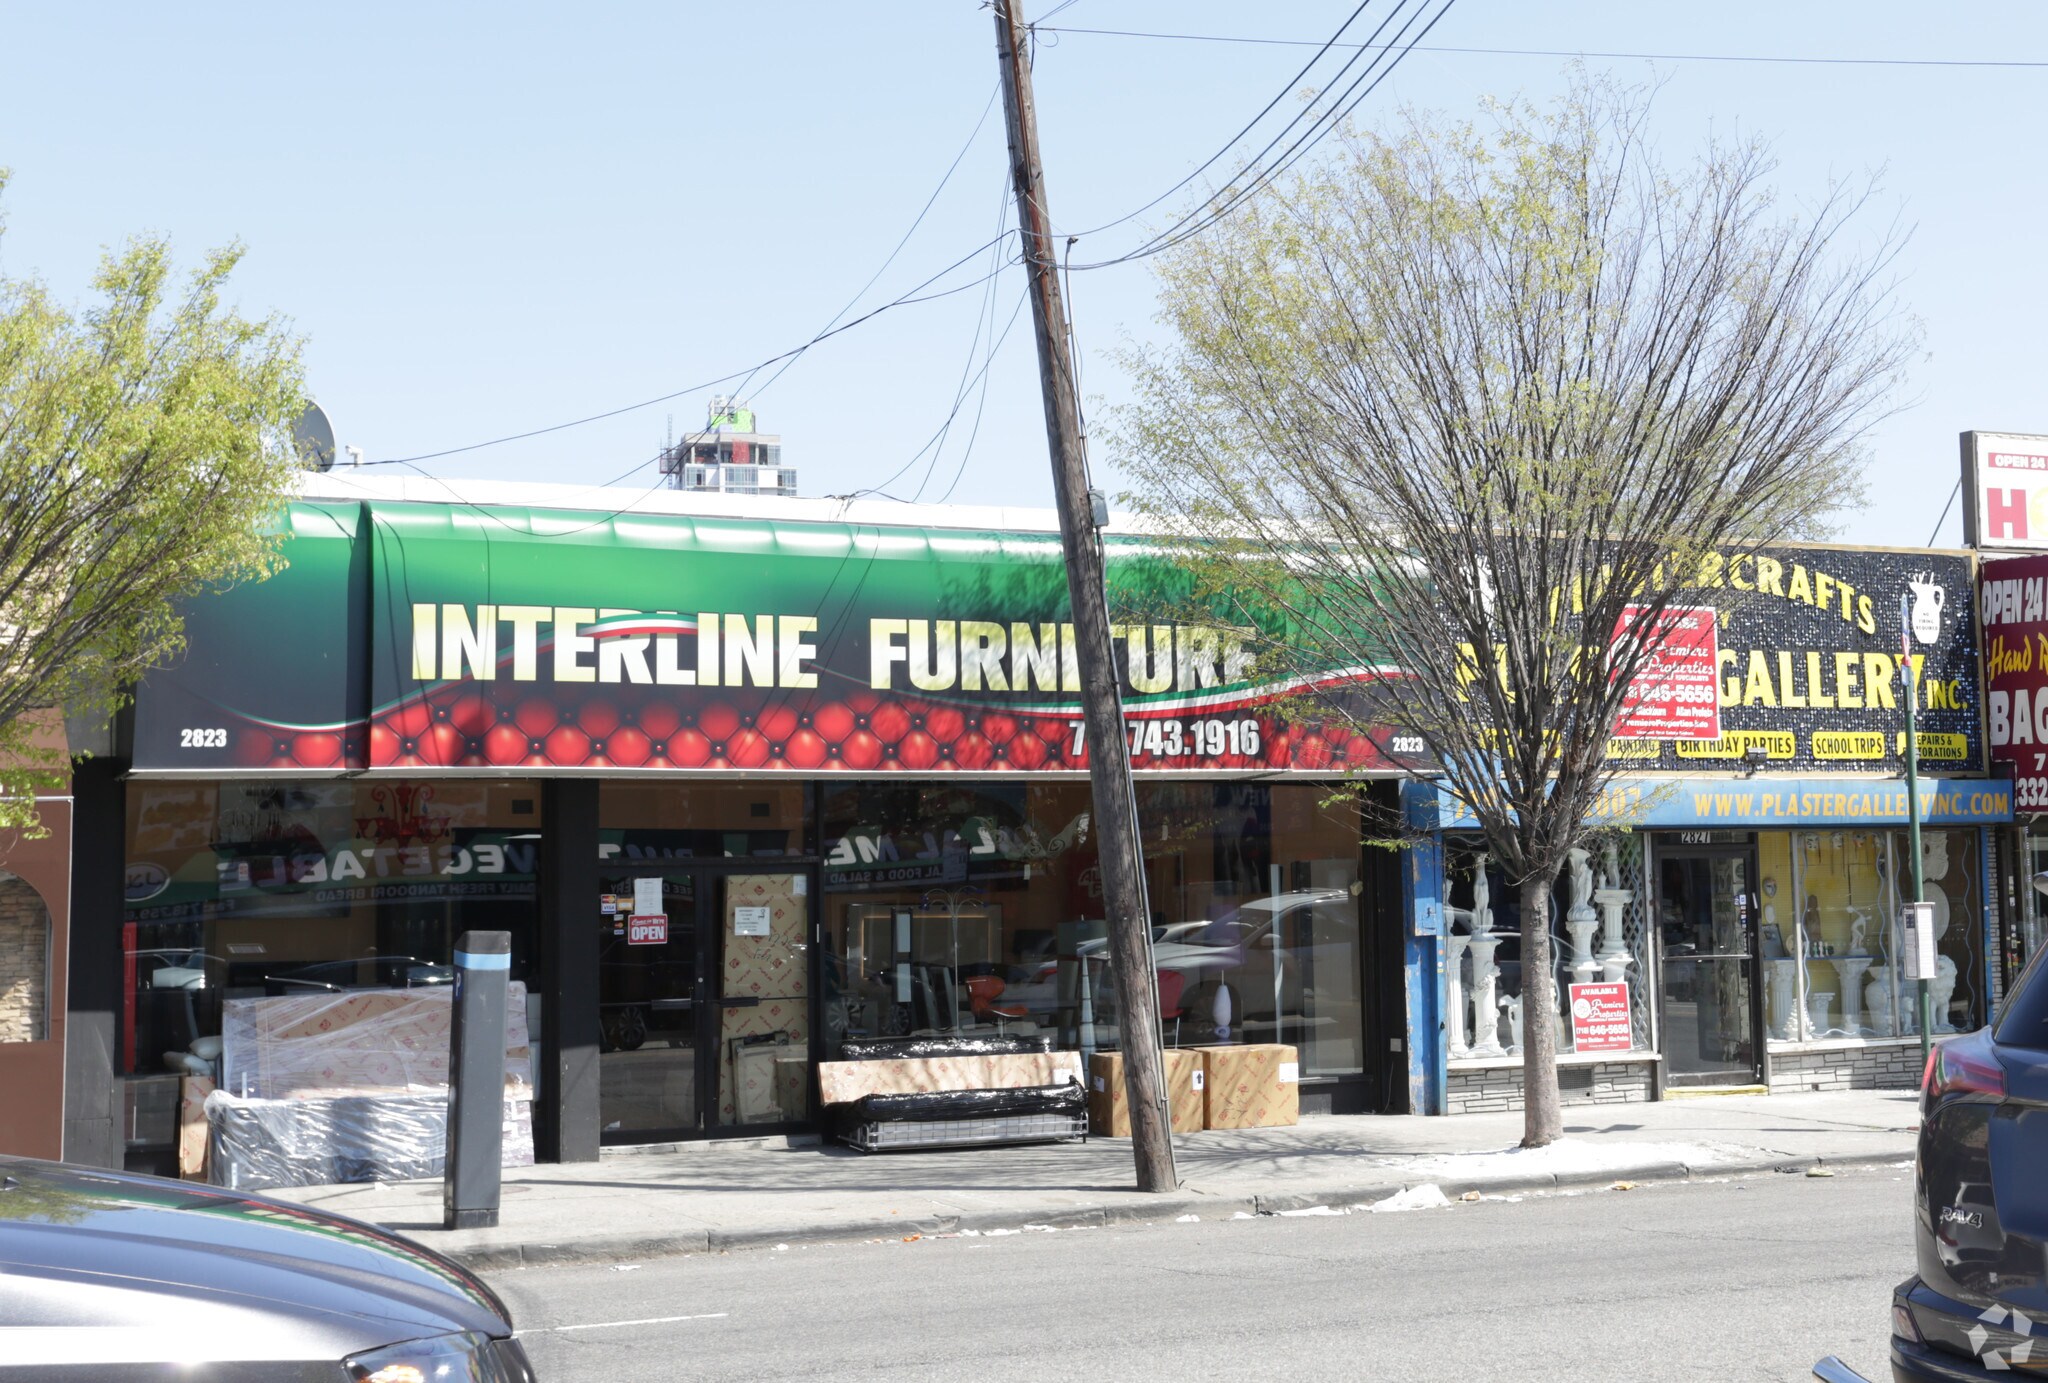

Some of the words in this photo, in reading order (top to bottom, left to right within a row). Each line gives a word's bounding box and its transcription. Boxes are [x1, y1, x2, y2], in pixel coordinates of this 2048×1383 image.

[1995, 454, 2029, 468] OPEN
[2031, 456, 2046, 469] 24
[1982, 579, 2022, 626] OPEN
[2025, 577, 2043, 622] 24
[412, 603, 818, 689] INTERLINE
[870, 618, 1257, 694] FURNIURE
[1989, 634, 2032, 681] Hand
[1640, 655, 1715, 680] Properties
[1718, 648, 1925, 710] GALLERY
[1926, 679, 1968, 710] INC.
[1640, 683, 1715, 704] 646-5656
[181, 728, 227, 747] 2823
[1069, 719, 1260, 756] 7.743.1916
[1392, 736, 1424, 753] 2823
[1681, 736, 1741, 753] BIRTHDAY
[1744, 736, 1792, 754] PARTIES
[1816, 737, 1853, 754] SCHOOL
[1854, 737, 1882, 754] TRIPS
[1915, 735, 1945, 745] EPAIRS
[1694, 792, 2008, 817] WWW.PLASTERGALLEYINC.COM
[1682, 831, 1710, 844] 2827
[631, 925, 665, 941] OPEN
[1581, 987, 1618, 996] AVAILABLE
[1589, 1024, 1629, 1035] 646-5656
[1940, 1206, 1983, 1229] RAV4
